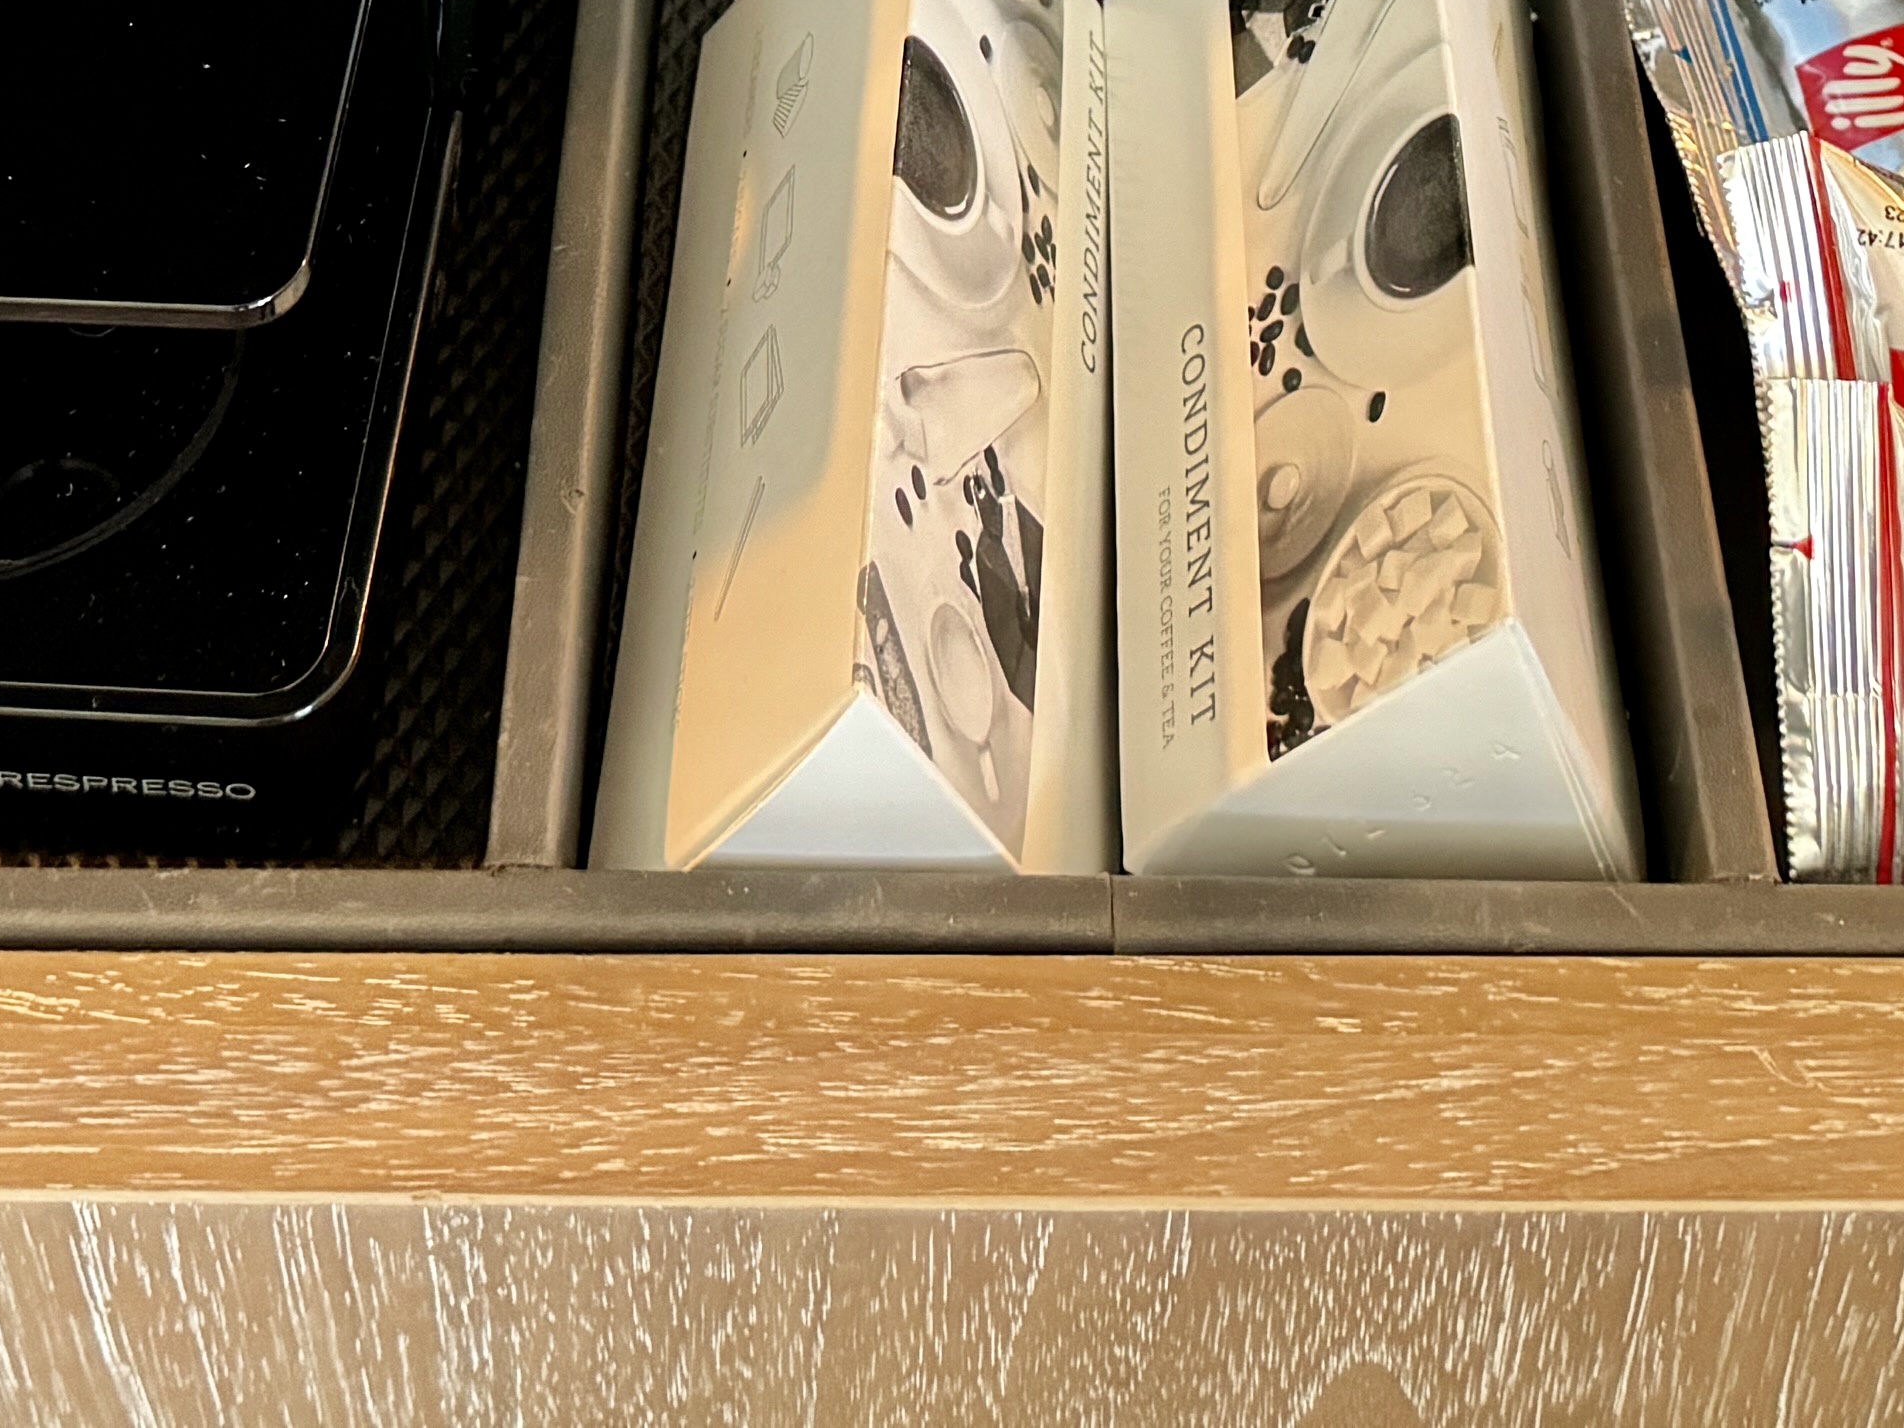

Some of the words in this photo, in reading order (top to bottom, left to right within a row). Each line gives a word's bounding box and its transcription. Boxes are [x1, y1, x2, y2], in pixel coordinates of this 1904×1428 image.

[1089, 30, 1105, 105] KIT
[1081, 109, 1105, 374] CONDIMENT
[1158, 485, 1171, 526] FOR
[1181, 323, 1214, 618] CONDIMENT
[1159, 528, 1174, 591] YOUR
[1160, 595, 1175, 681] COFFEE
[1189, 634, 1217, 727] KIT
[1162, 704, 1177, 750] TEA
